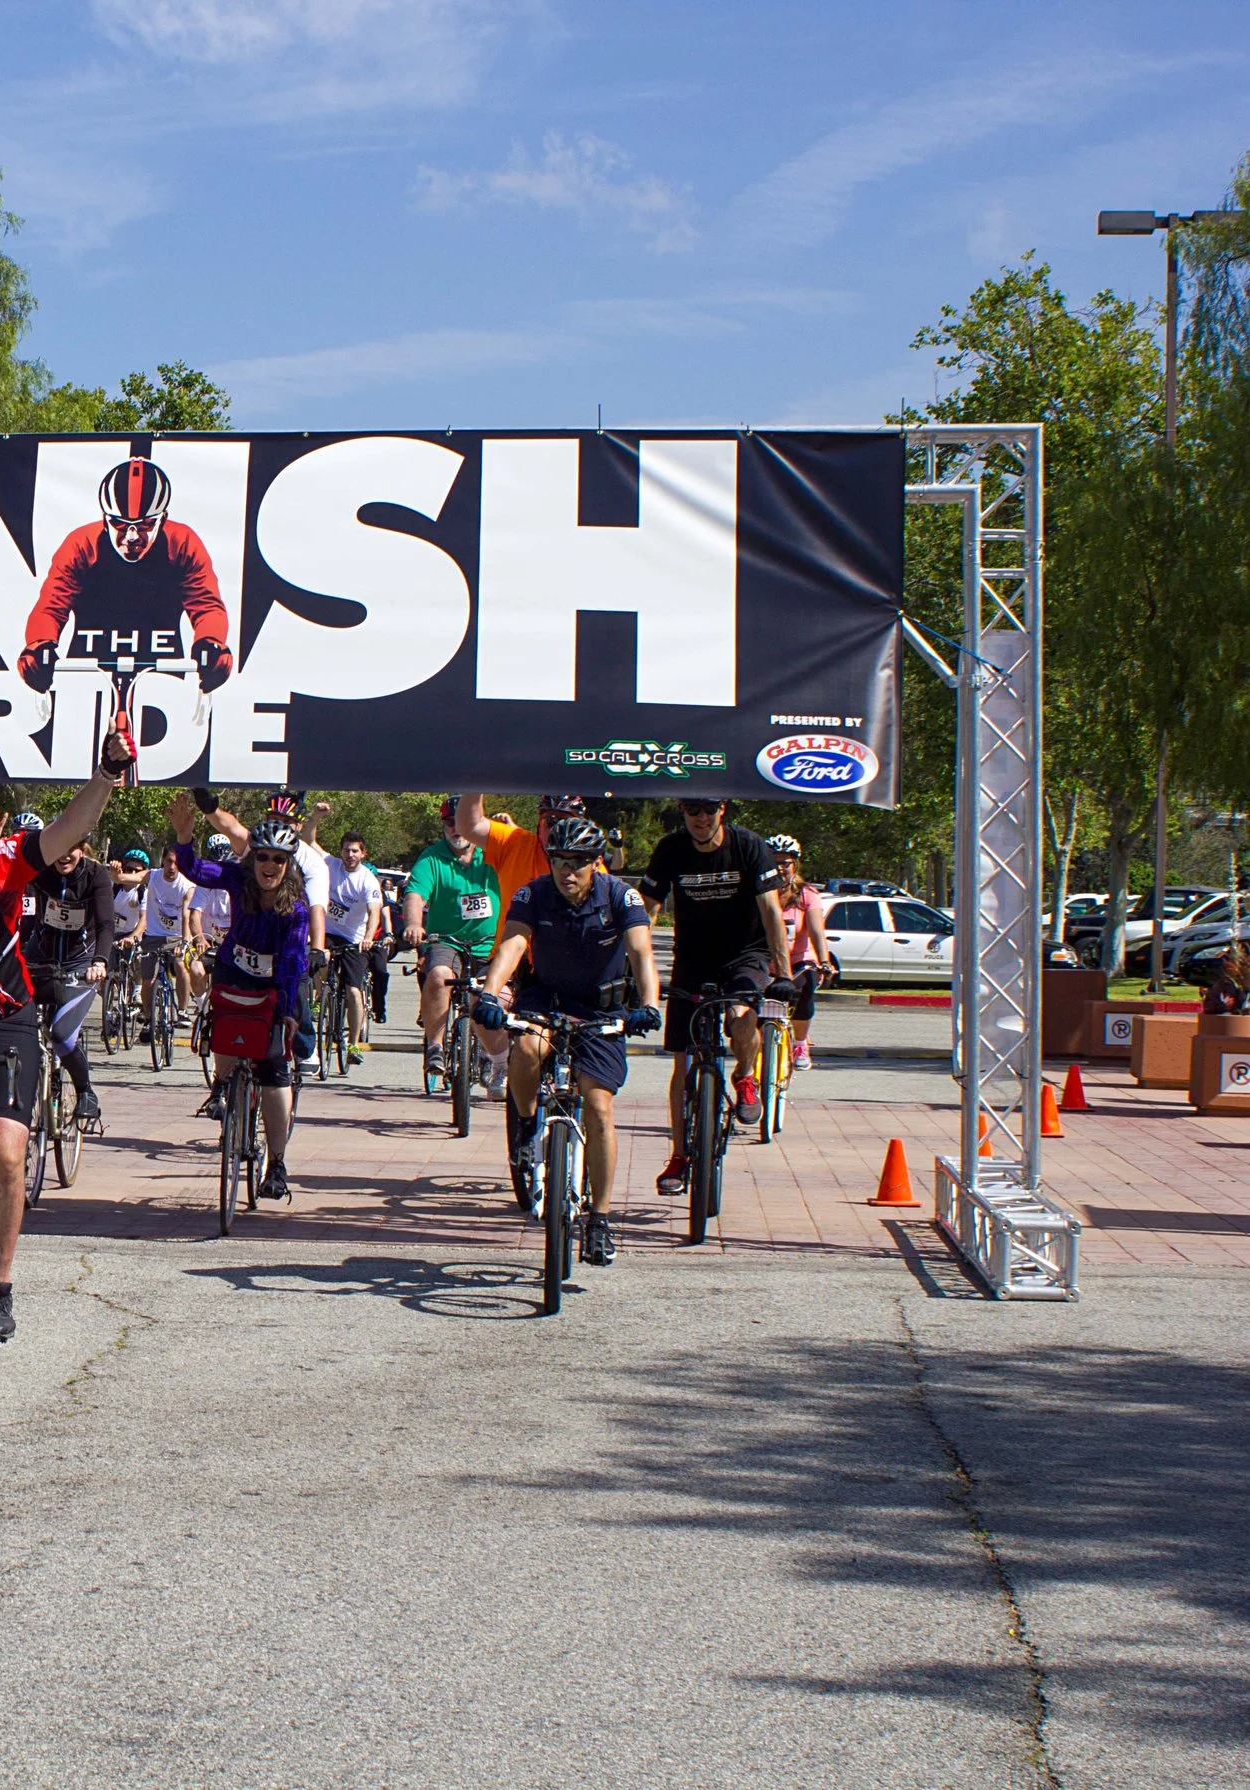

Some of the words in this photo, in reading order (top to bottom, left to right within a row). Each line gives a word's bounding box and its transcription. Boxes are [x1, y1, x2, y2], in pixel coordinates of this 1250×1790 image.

[77, 630, 175, 653] THE
[770, 715, 842, 726] PRESENTED
[845, 717, 863, 727] BY
[766, 737, 869, 761] GALPIN
[653, 752, 724, 766] CROSS
[783, 755, 853, 780] Ford
[466, 898, 487, 911] 285
[60, 908, 69, 921] 5
[245, 955, 259, 969] 11
